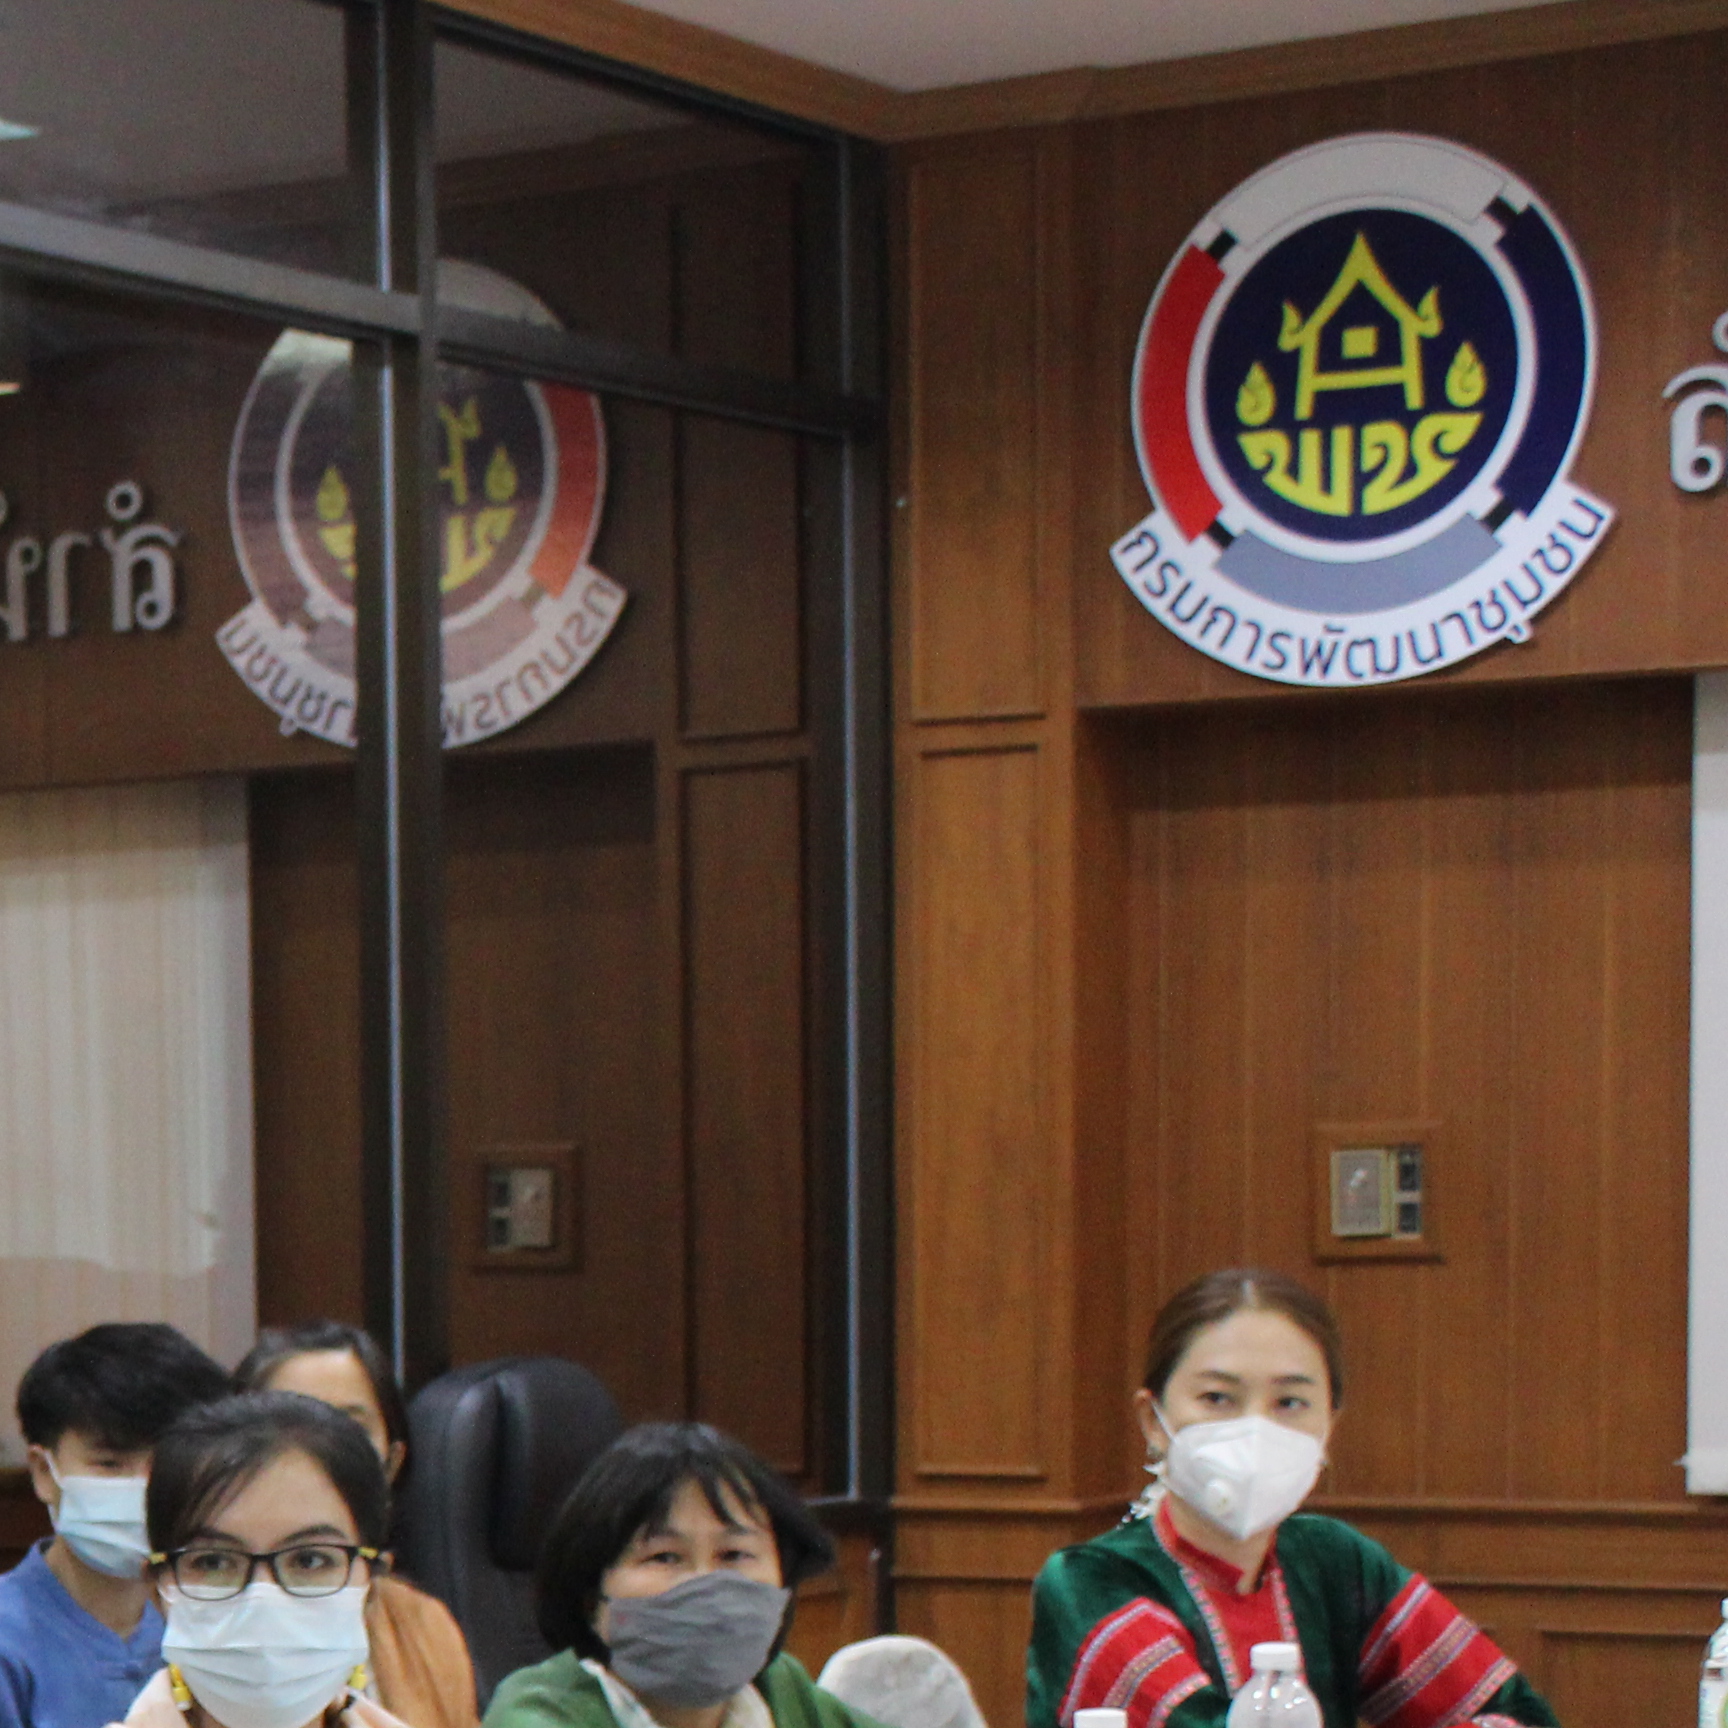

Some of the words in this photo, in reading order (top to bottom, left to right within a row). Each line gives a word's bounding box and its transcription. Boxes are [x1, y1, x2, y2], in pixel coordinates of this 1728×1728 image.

[1119, 496, 1607, 679] กรมการพัฒนาชุมชน
